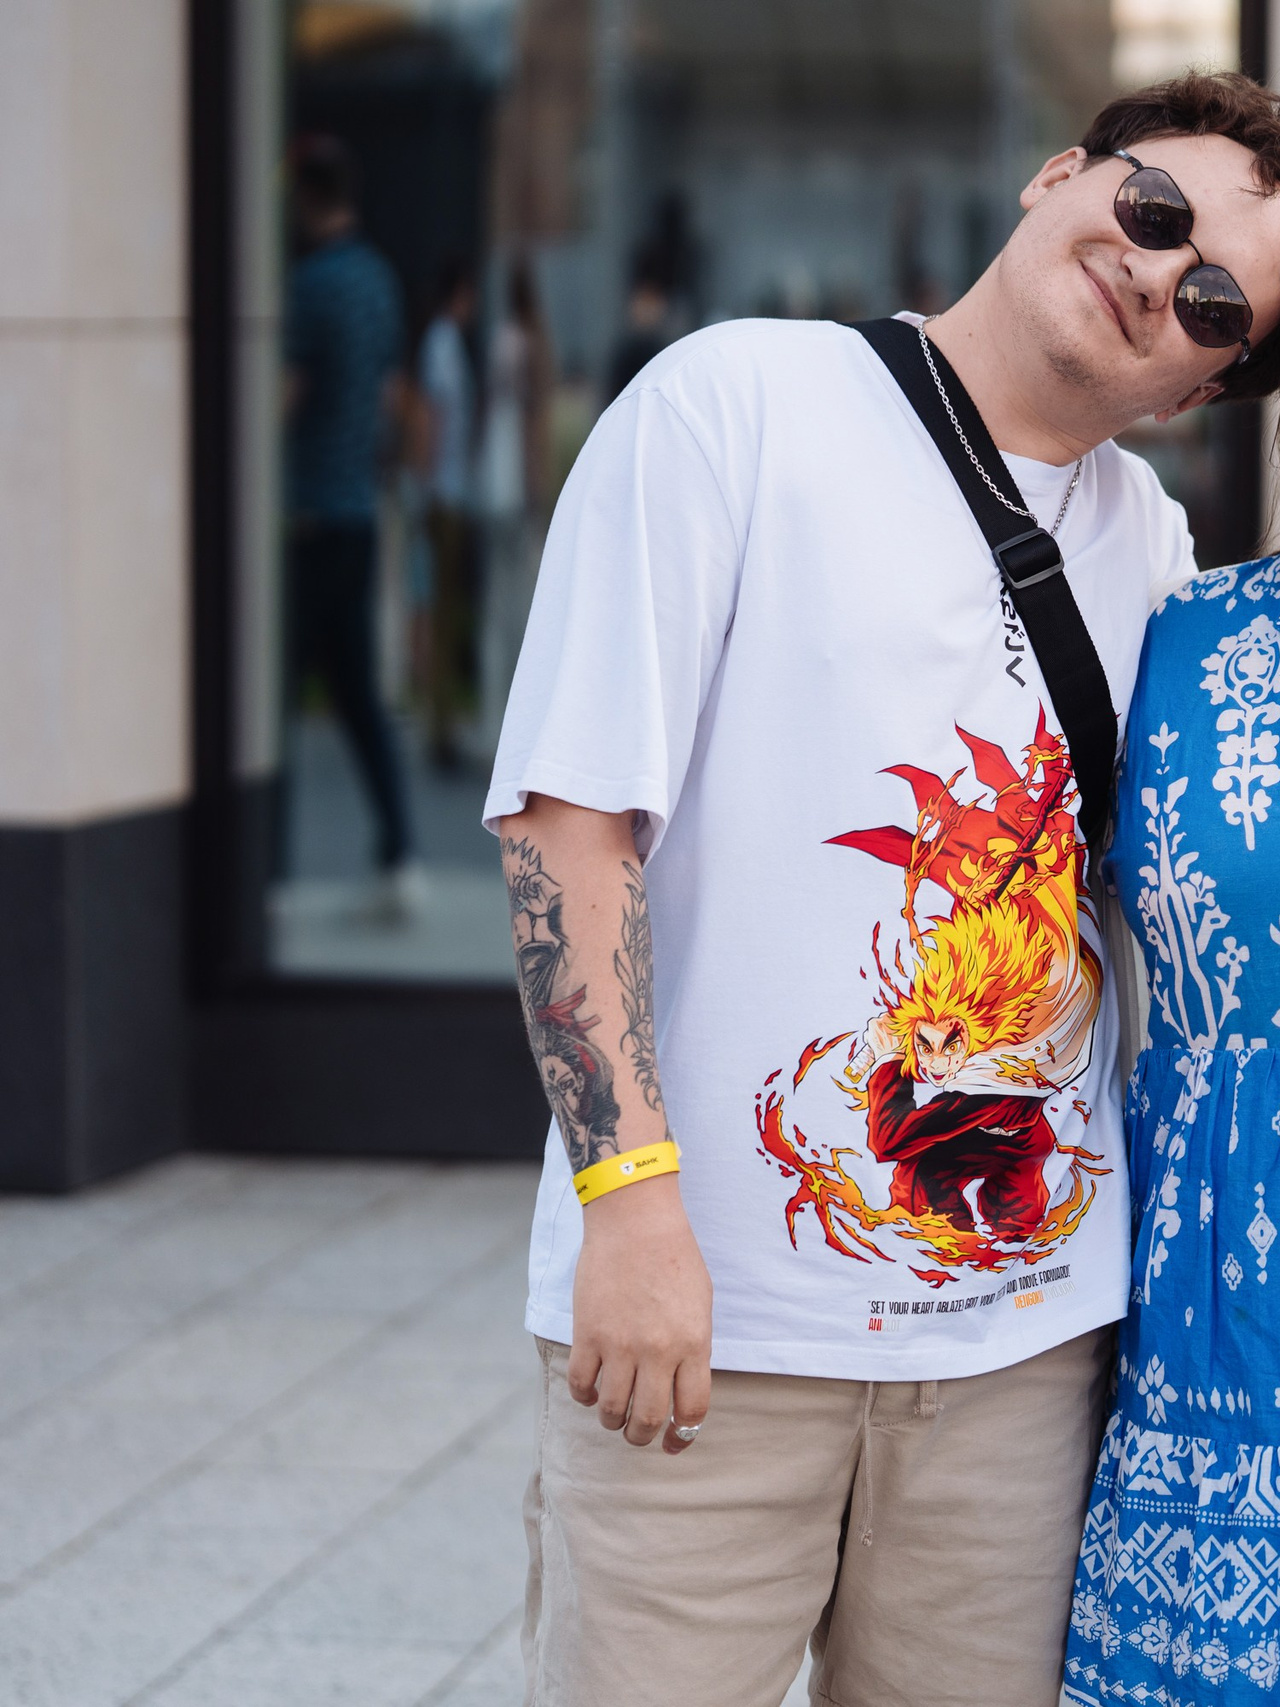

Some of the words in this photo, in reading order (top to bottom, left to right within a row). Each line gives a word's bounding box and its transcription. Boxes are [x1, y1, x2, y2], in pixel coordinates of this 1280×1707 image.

[635, 1157, 659, 1169] БАНК
[889, 1301, 910, 1315] YOUR
[911, 1301, 935, 1315] HEART
[1006, 1279, 1018, 1295] AND
[1018, 1273, 1039, 1290] MOVE
